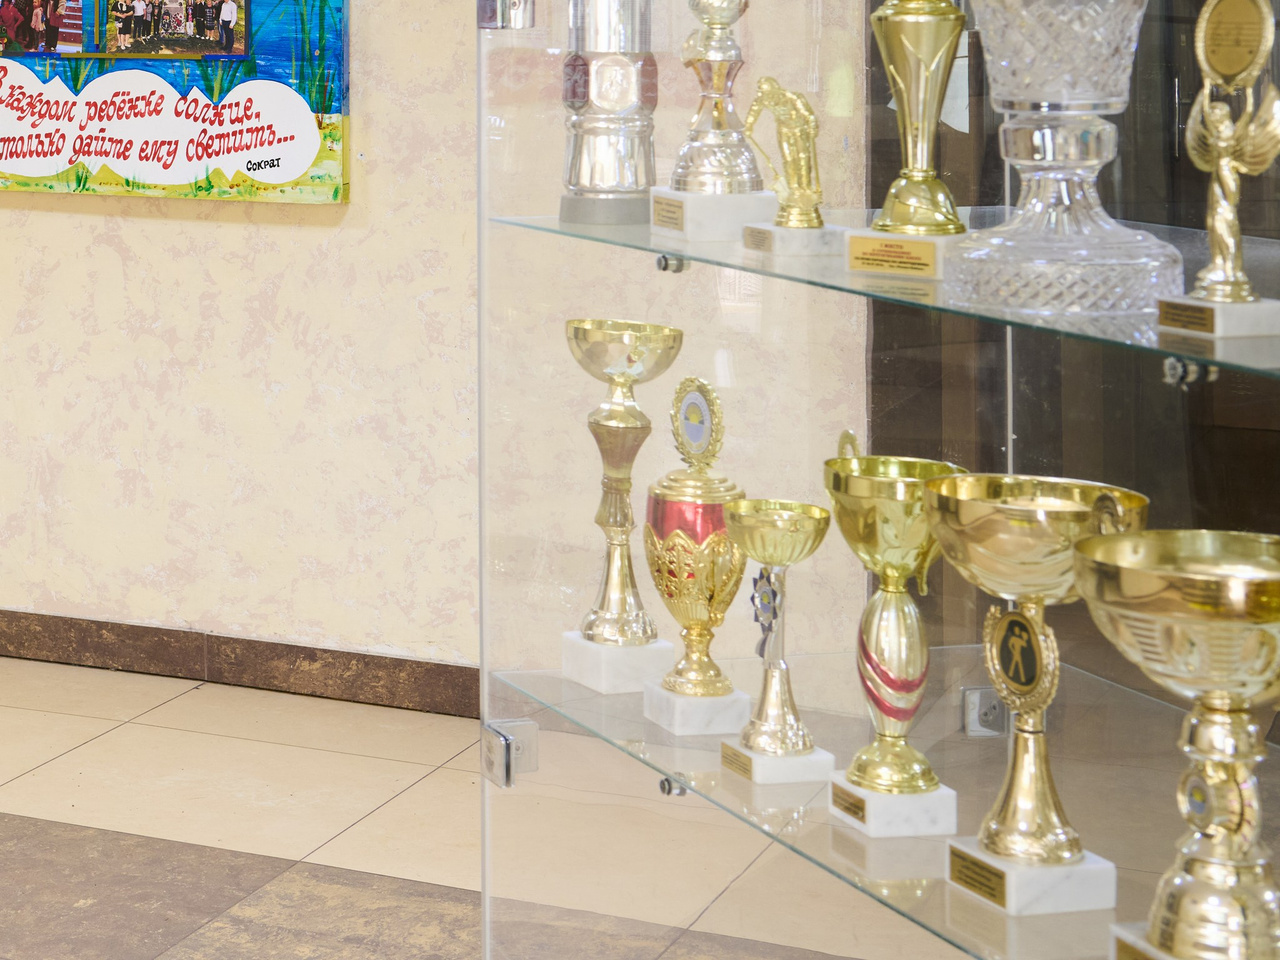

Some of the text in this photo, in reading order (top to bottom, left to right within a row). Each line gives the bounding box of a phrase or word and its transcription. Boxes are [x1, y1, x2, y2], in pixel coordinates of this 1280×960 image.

[80, 89, 165, 131] ребёнке
[174, 96, 261, 127] солнце,
[68, 128, 132, 165] дайте
[139, 138, 178, 171] ему
[185, 124, 296, 162] светить...
